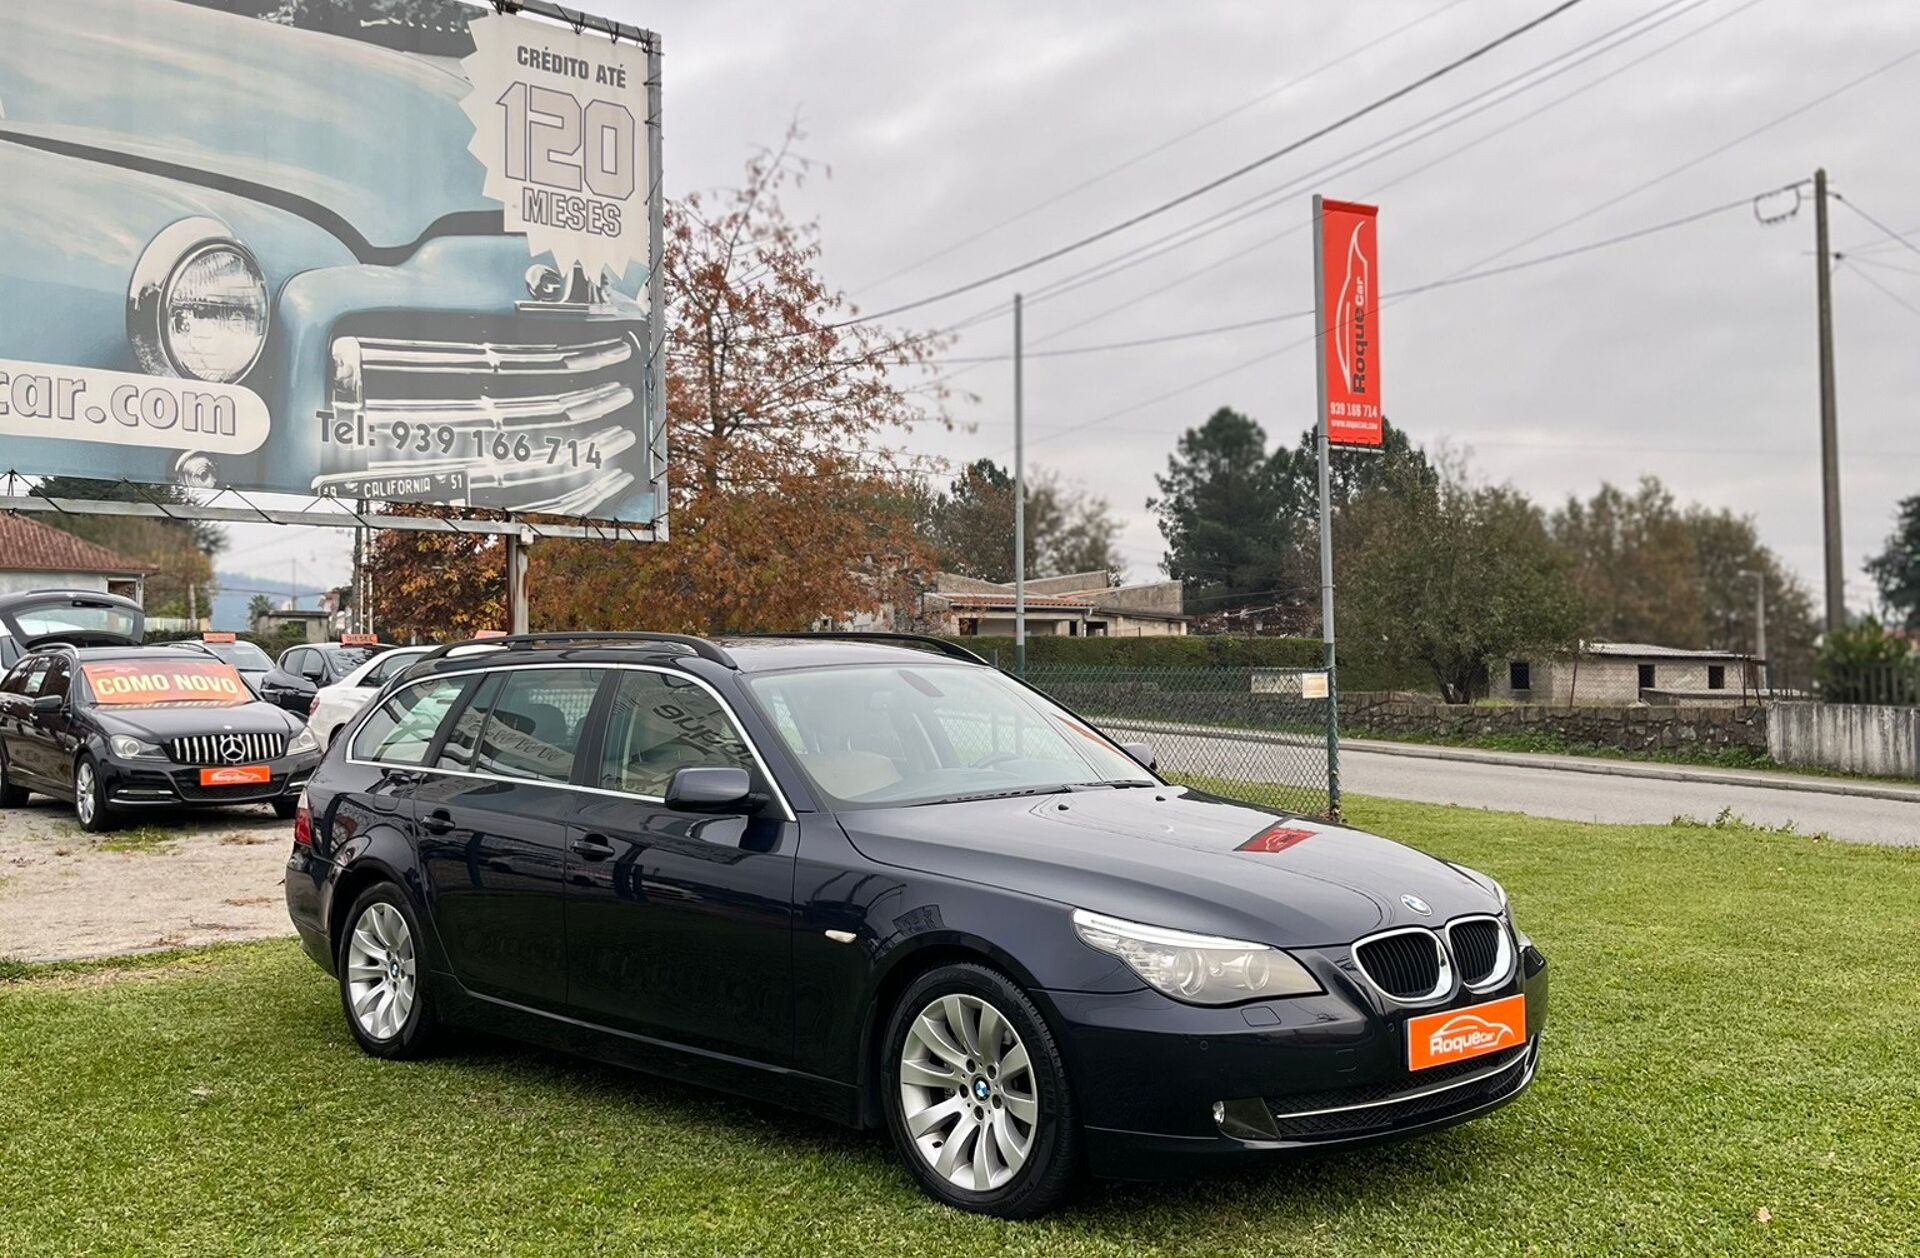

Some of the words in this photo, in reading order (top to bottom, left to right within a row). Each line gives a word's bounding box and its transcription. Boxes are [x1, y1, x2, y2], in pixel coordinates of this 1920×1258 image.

[517, 45, 589, 80] CRÉDITO
[596, 63, 626, 89] ATÉ
[496, 81, 635, 201] 120
[522, 187, 621, 237] MESES
[1362, 404, 1377, 418] 714
[315, 410, 375, 447] Tel:
[391, 420, 455, 455] 939
[472, 430, 531, 462] 166
[545, 437, 601, 469] 714
[364, 478, 430, 498] CALIFORNIA
[451, 474, 462, 489] 51
[97, 674, 170, 695] COMO
[174, 674, 239, 694] NOVO
